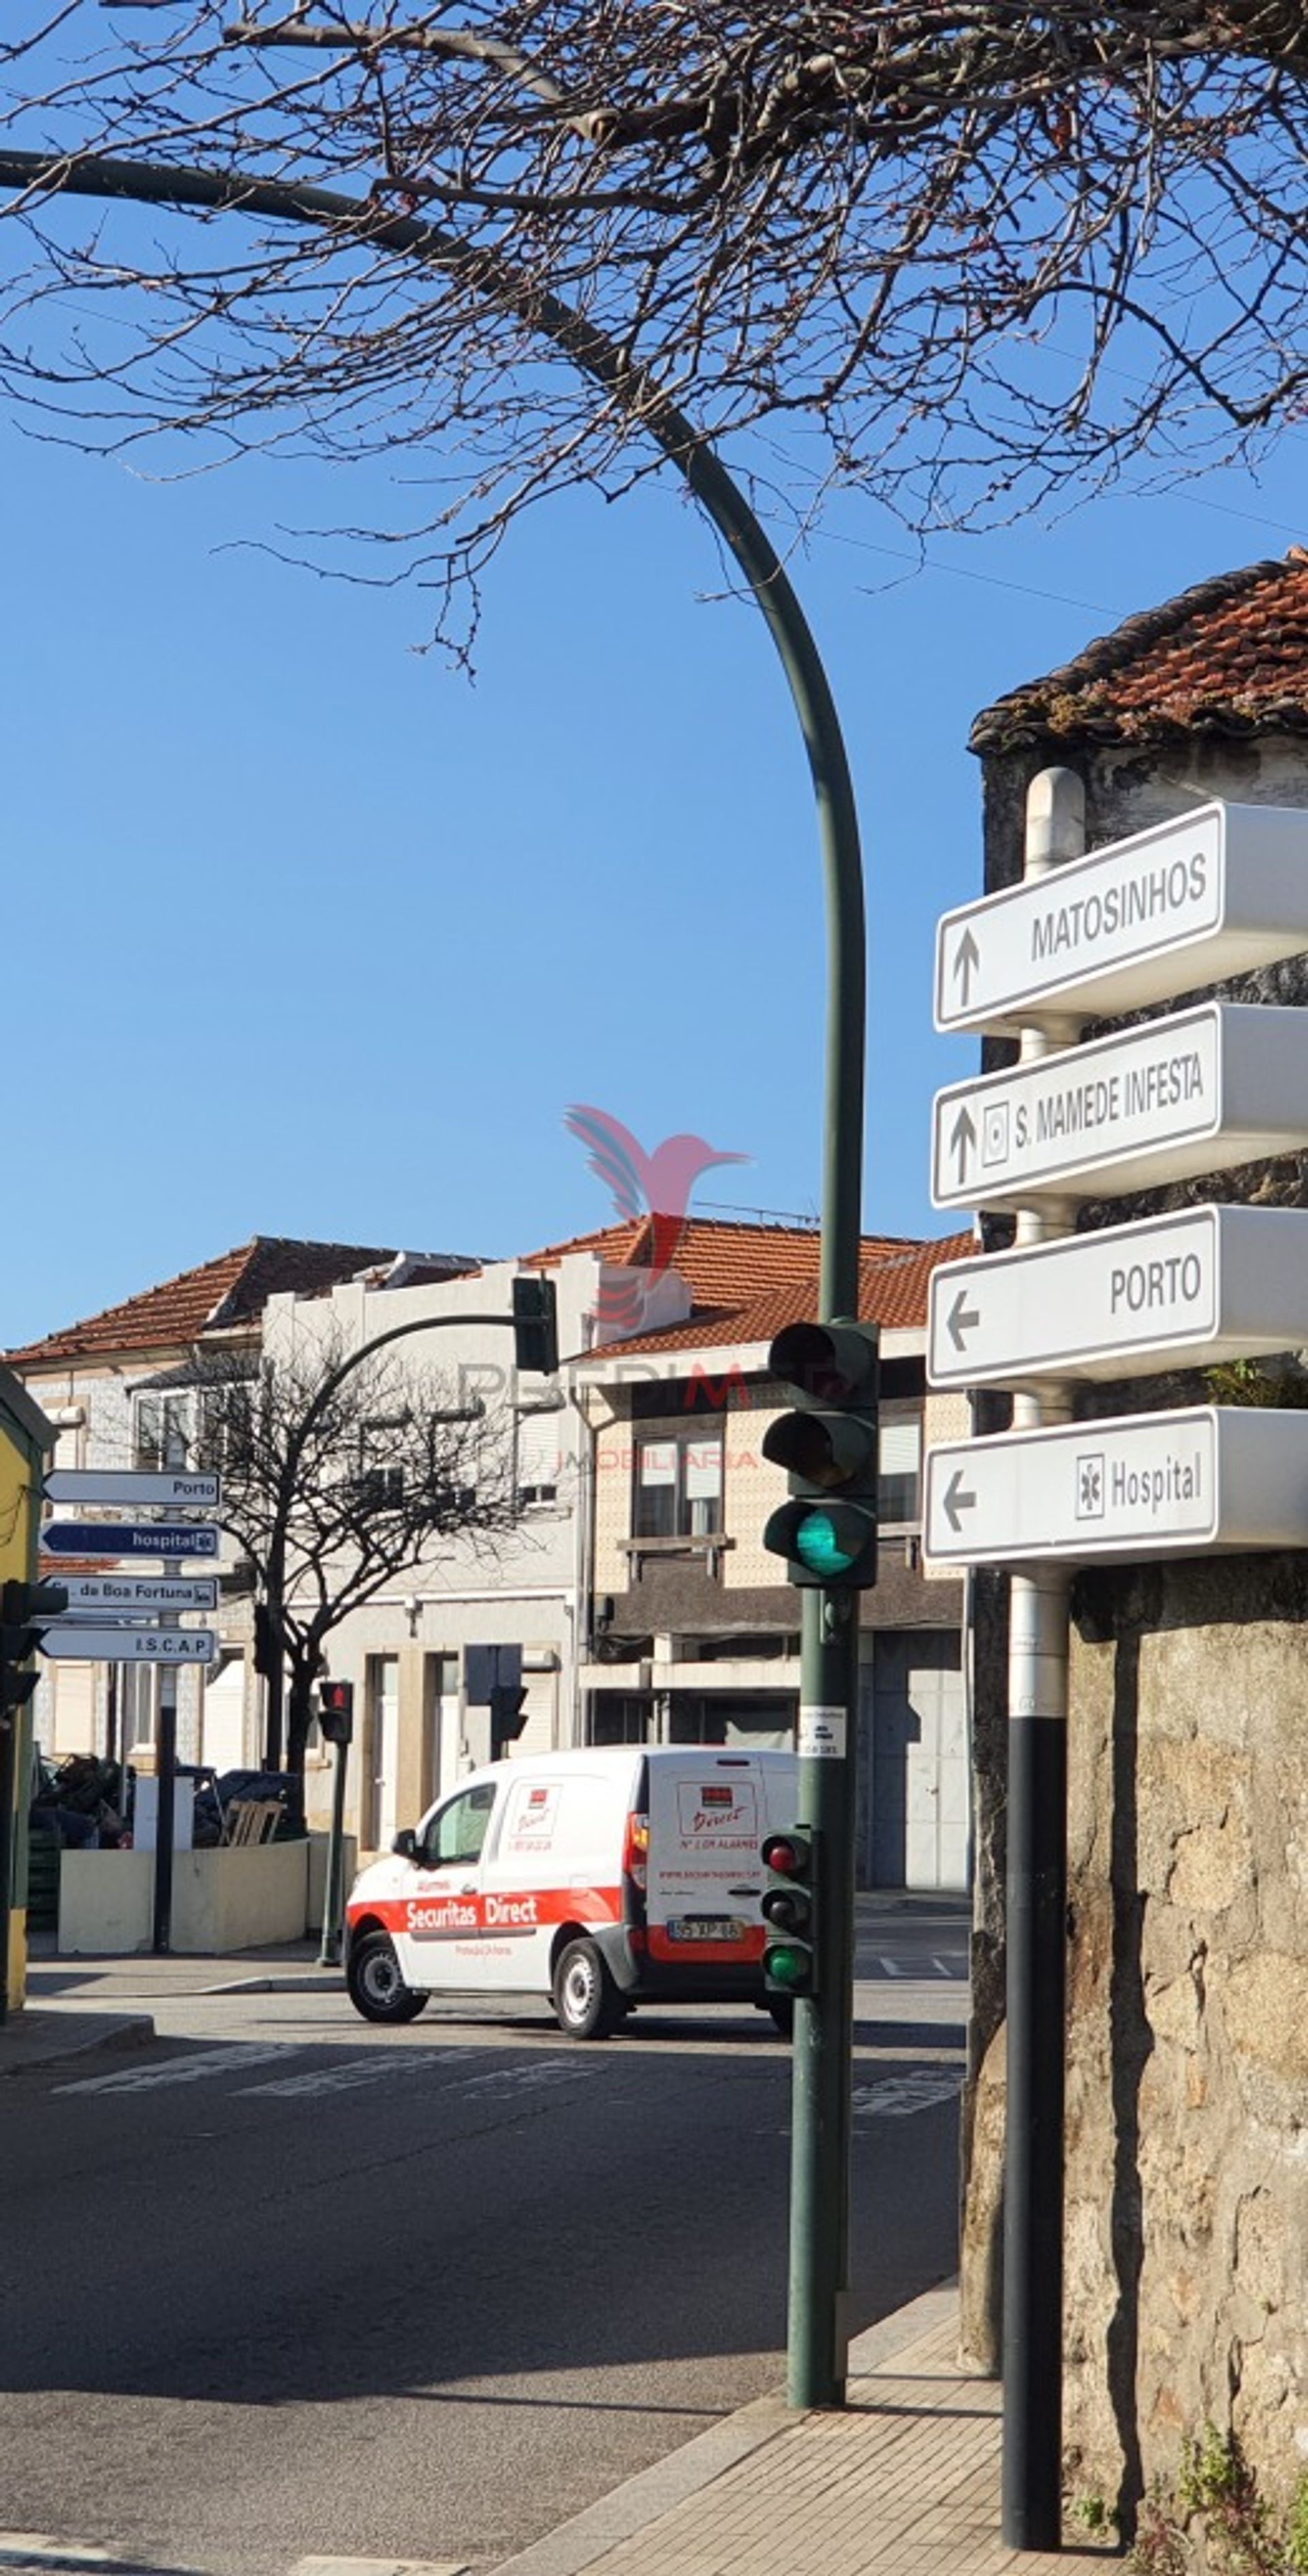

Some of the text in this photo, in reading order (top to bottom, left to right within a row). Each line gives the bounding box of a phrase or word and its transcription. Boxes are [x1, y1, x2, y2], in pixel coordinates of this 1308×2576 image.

[1031, 852, 1206, 962] MATOSINHOS
[1015, 1051, 1204, 1149] S. MAMEDE INFESTA
[1110, 1254, 1202, 1315] PORTO
[172, 1481, 215, 1495] Porto
[1111, 1452, 1202, 1515] Hospital
[132, 1532, 196, 1549] hospital
[102, 1584, 131, 1598] Boa
[135, 1585, 193, 1599] Fortuna
[407, 1896, 538, 1929] Securitas Direct
